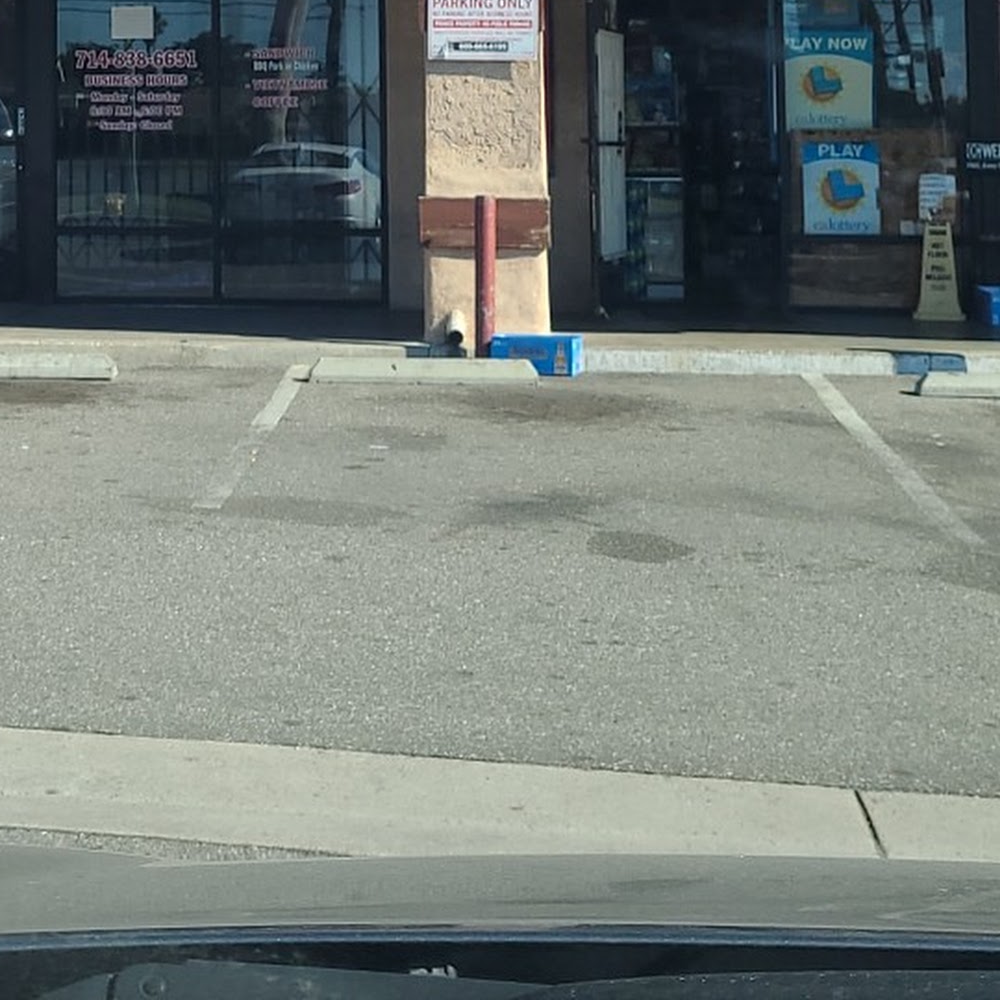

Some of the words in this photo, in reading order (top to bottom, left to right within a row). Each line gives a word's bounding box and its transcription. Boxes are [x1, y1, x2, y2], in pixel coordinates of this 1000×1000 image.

[828, 37, 868, 51] NOW
[75, 49, 197, 70] 714-838-6651
[84, 74, 144, 87] BUSINESS
[146, 74, 188, 87] HOURS
[90, 91, 129, 103] Monday
[137, 90, 181, 103] Saturday
[140, 119, 173, 131] Closed
[817, 143, 864, 158] PLAY
